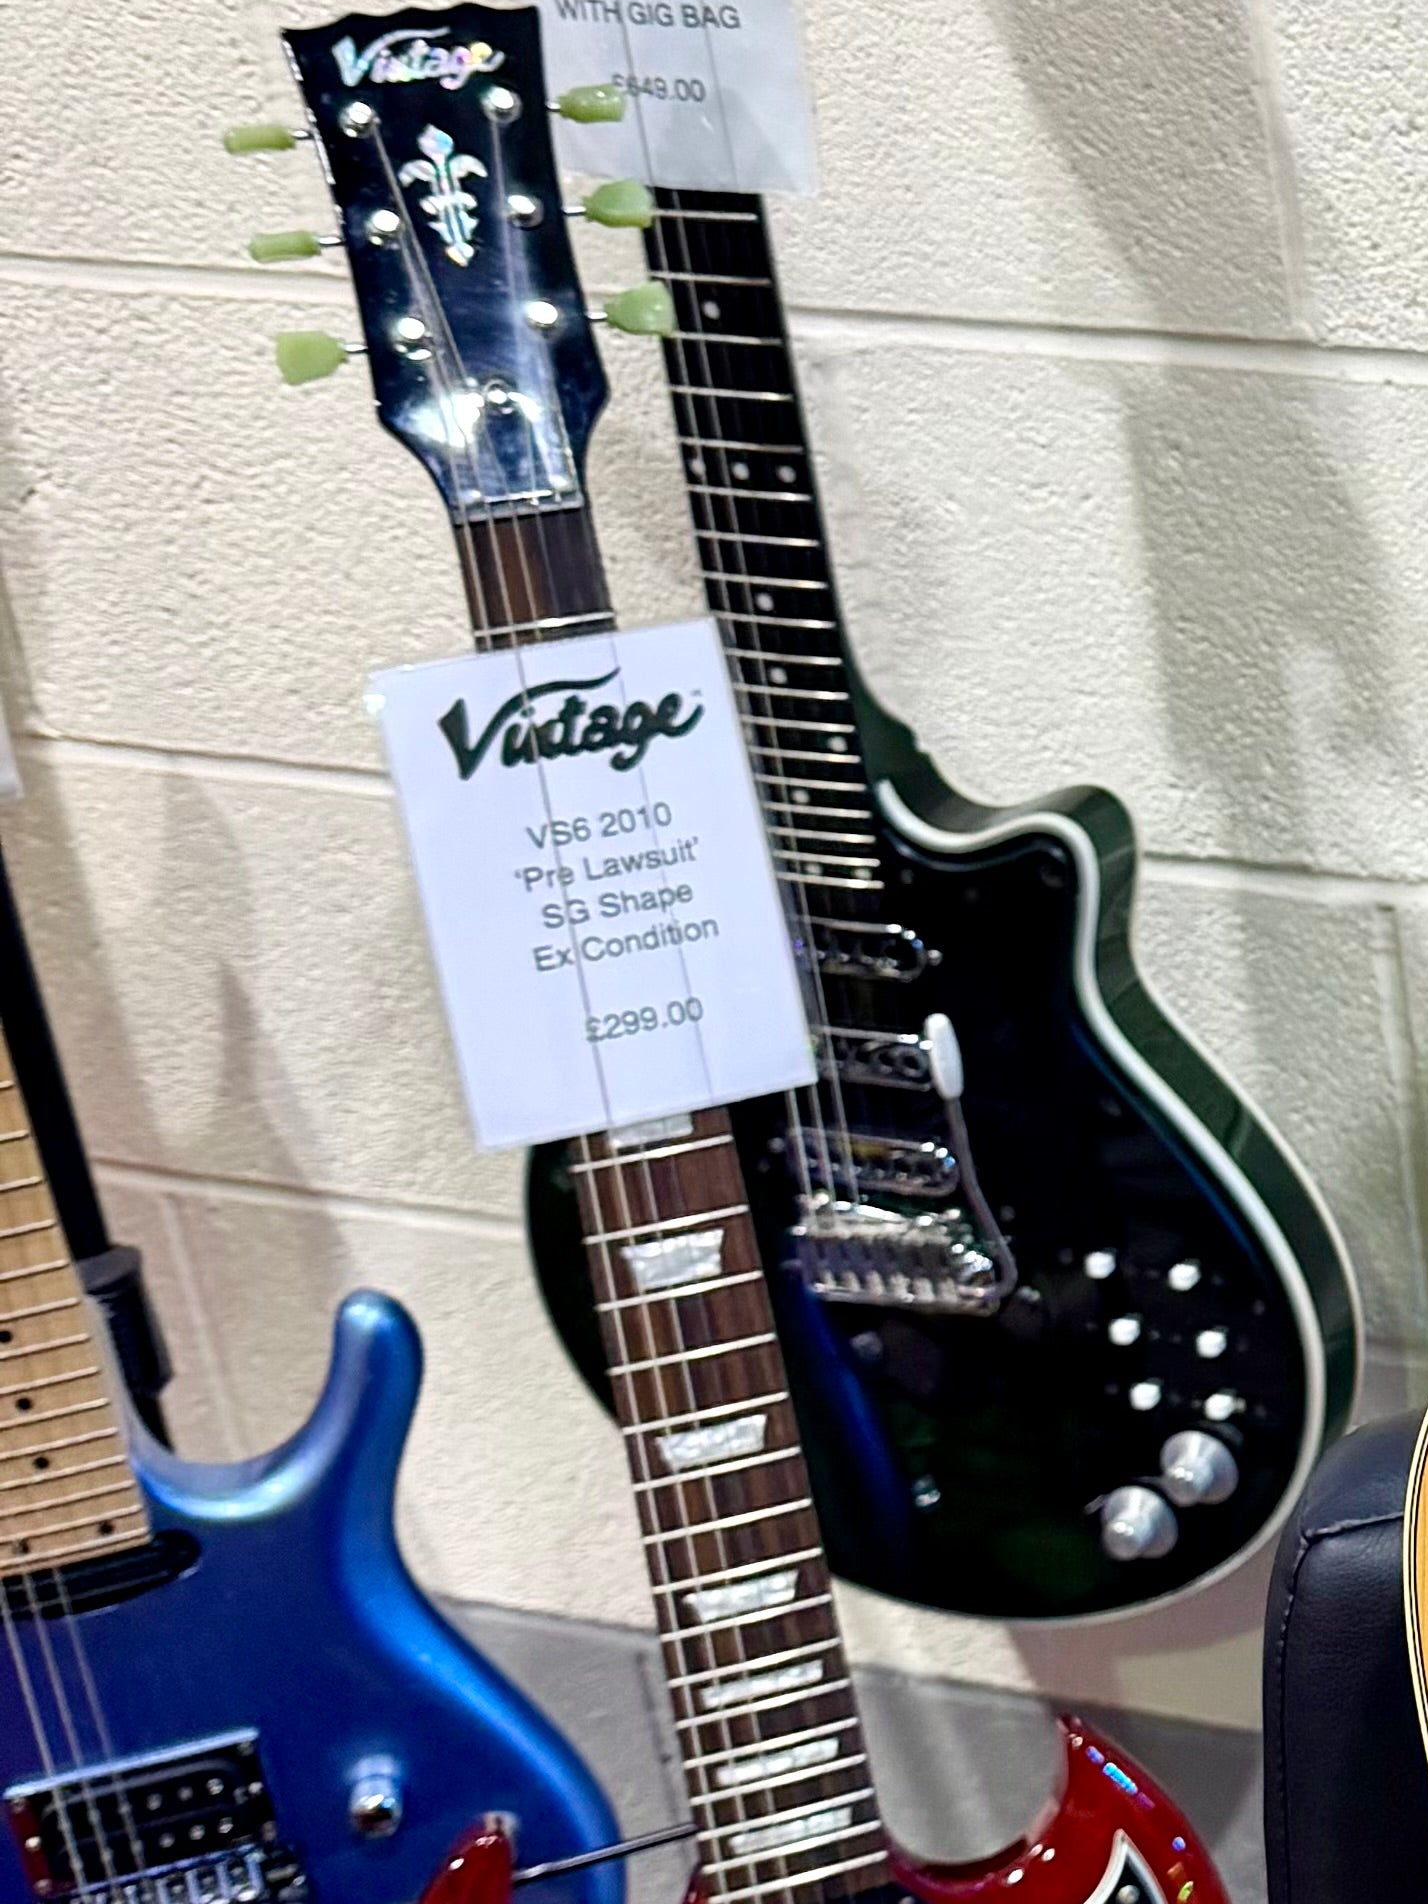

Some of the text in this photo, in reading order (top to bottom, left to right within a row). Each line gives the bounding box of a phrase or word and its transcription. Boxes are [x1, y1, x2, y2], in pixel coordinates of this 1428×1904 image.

[628, 1, 675, 28] GIG
[682, 4, 741, 31] BAG
[331, 26, 505, 90] Vintage
[437, 666, 704, 781] Vintage
[525, 801, 673, 850] VS6 2010
[541, 881, 693, 930] SG Shape
[534, 917, 719, 972] Ex Condition
[584, 997, 704, 1043] £299.00
